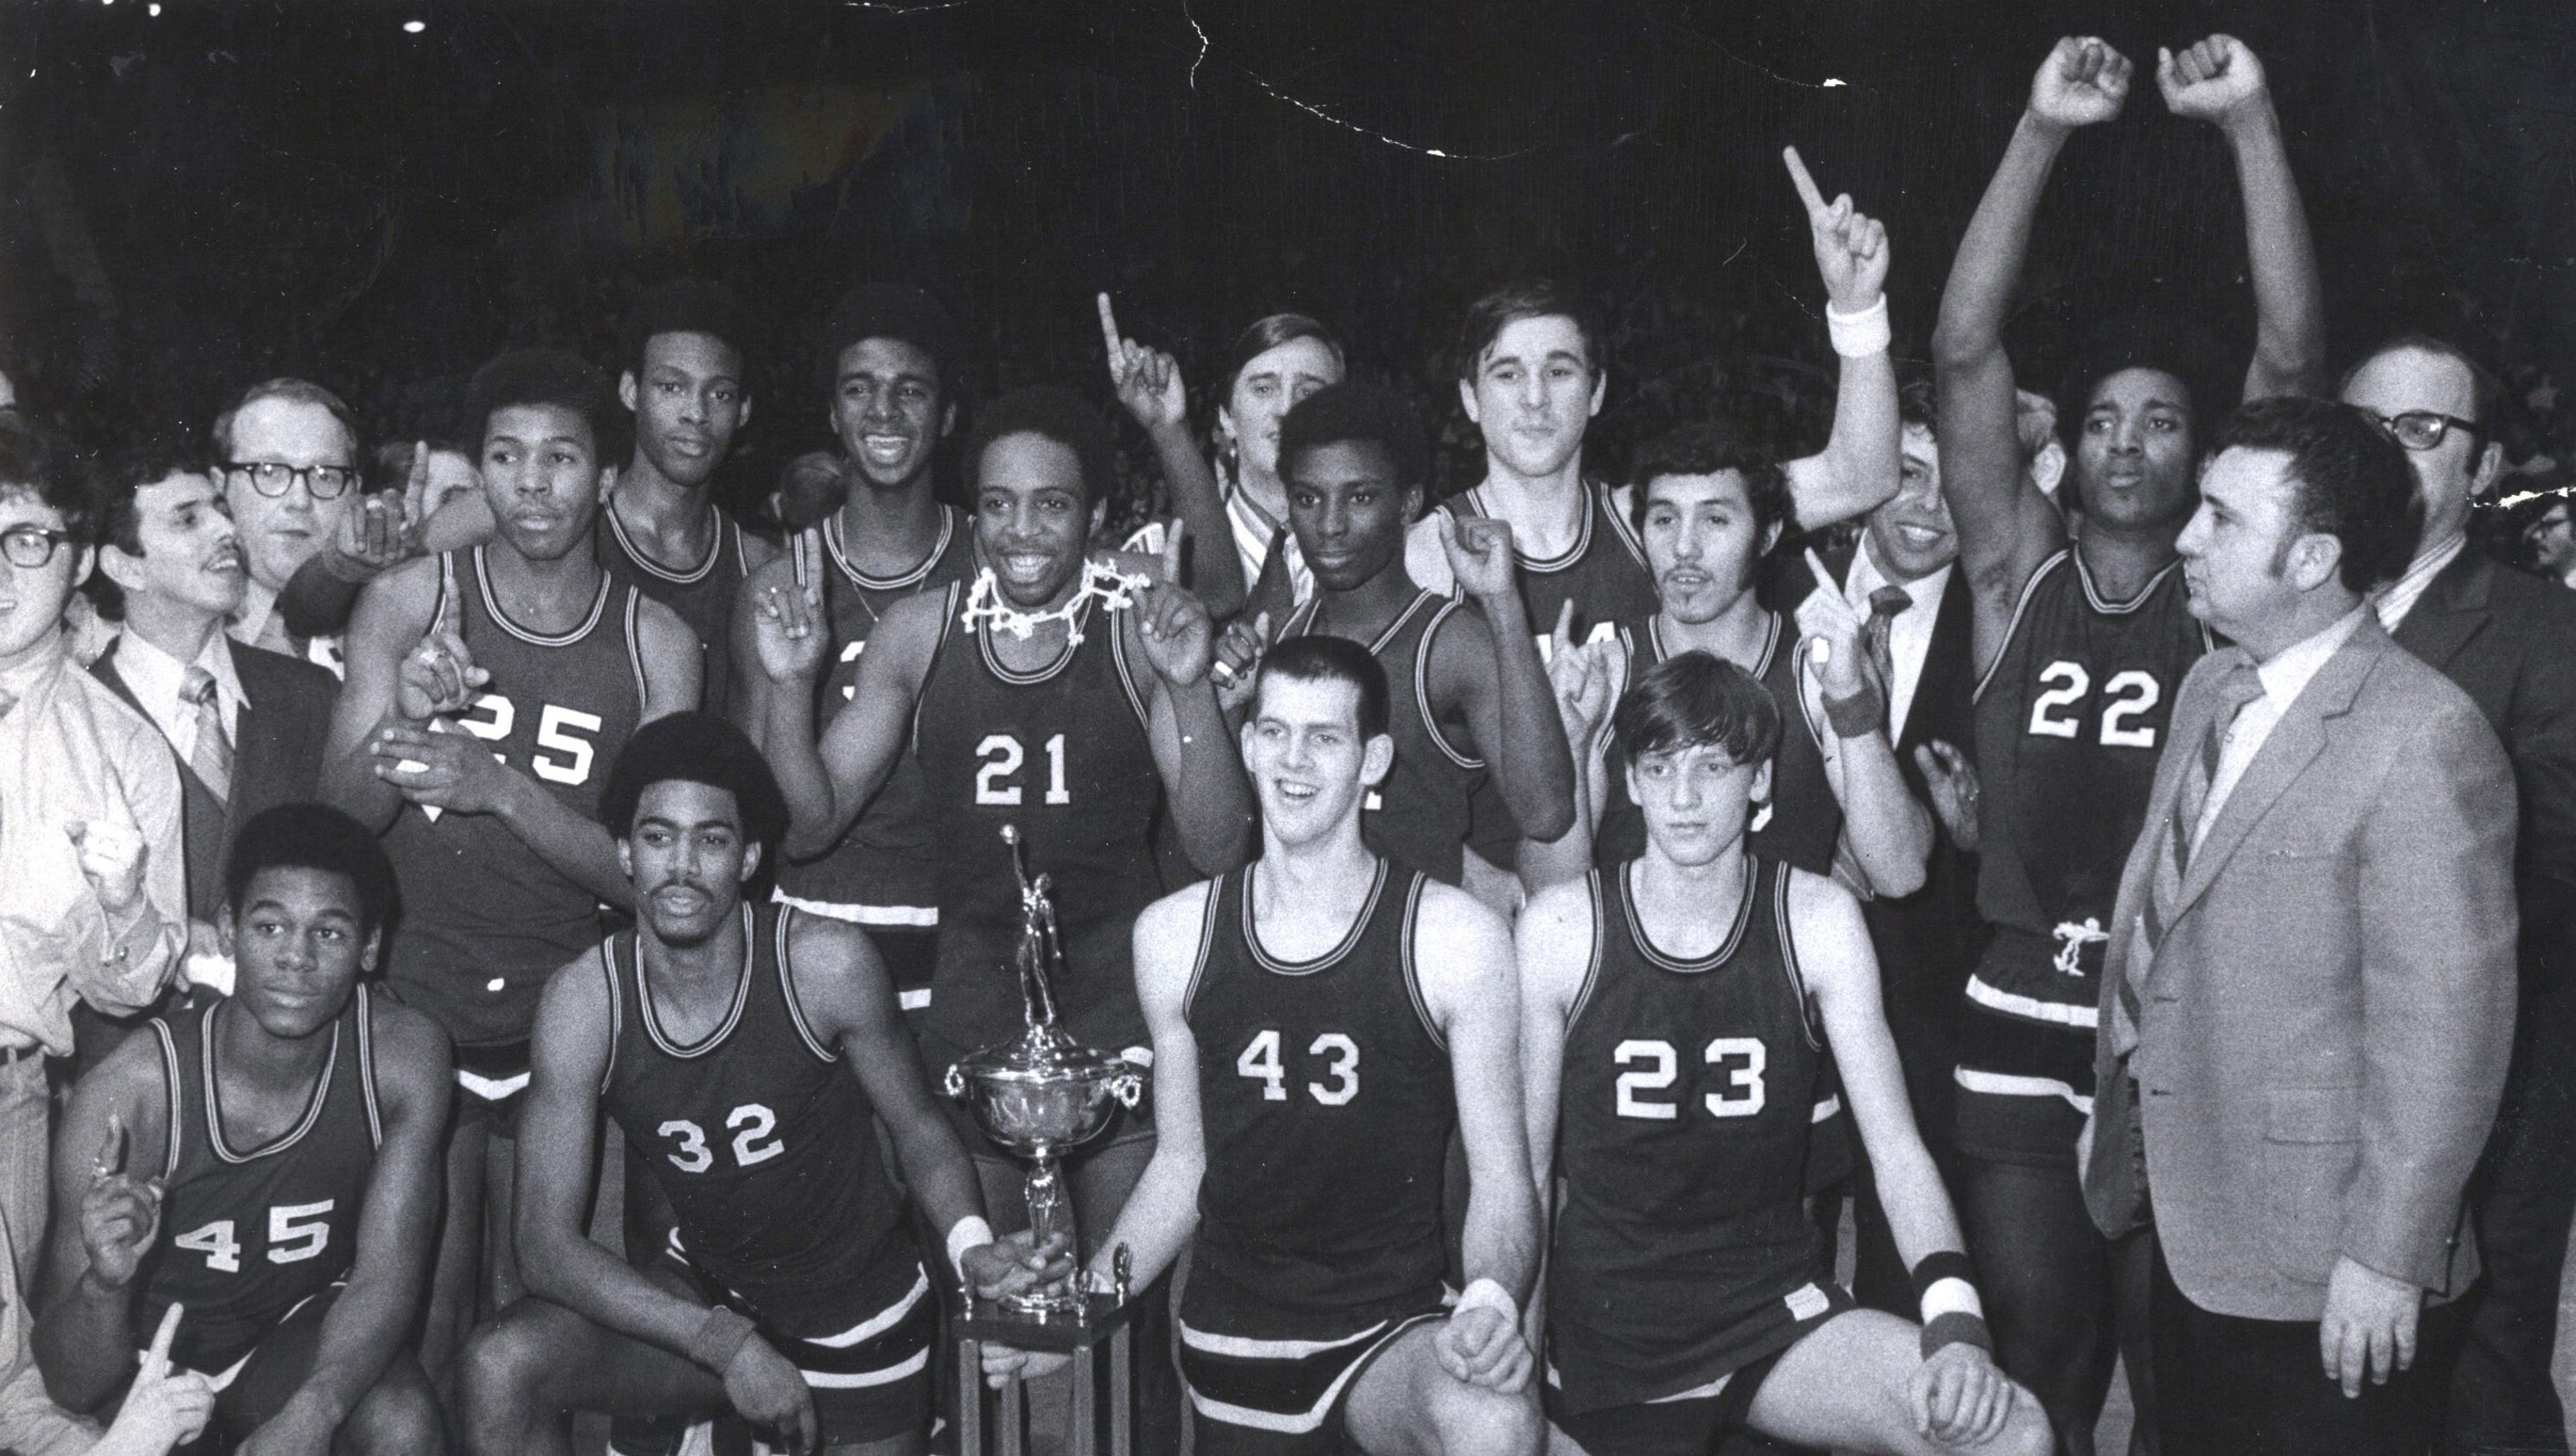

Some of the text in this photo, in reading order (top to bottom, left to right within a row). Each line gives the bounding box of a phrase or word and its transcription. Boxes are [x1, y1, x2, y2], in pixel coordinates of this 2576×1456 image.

[2028, 660, 2159, 747] 22
[975, 734, 1070, 805] 21
[1237, 1029, 1360, 1106] 43
[1613, 1037, 1767, 1119] 23
[657, 1103, 785, 1173] 32
[175, 1198, 334, 1273] 45
